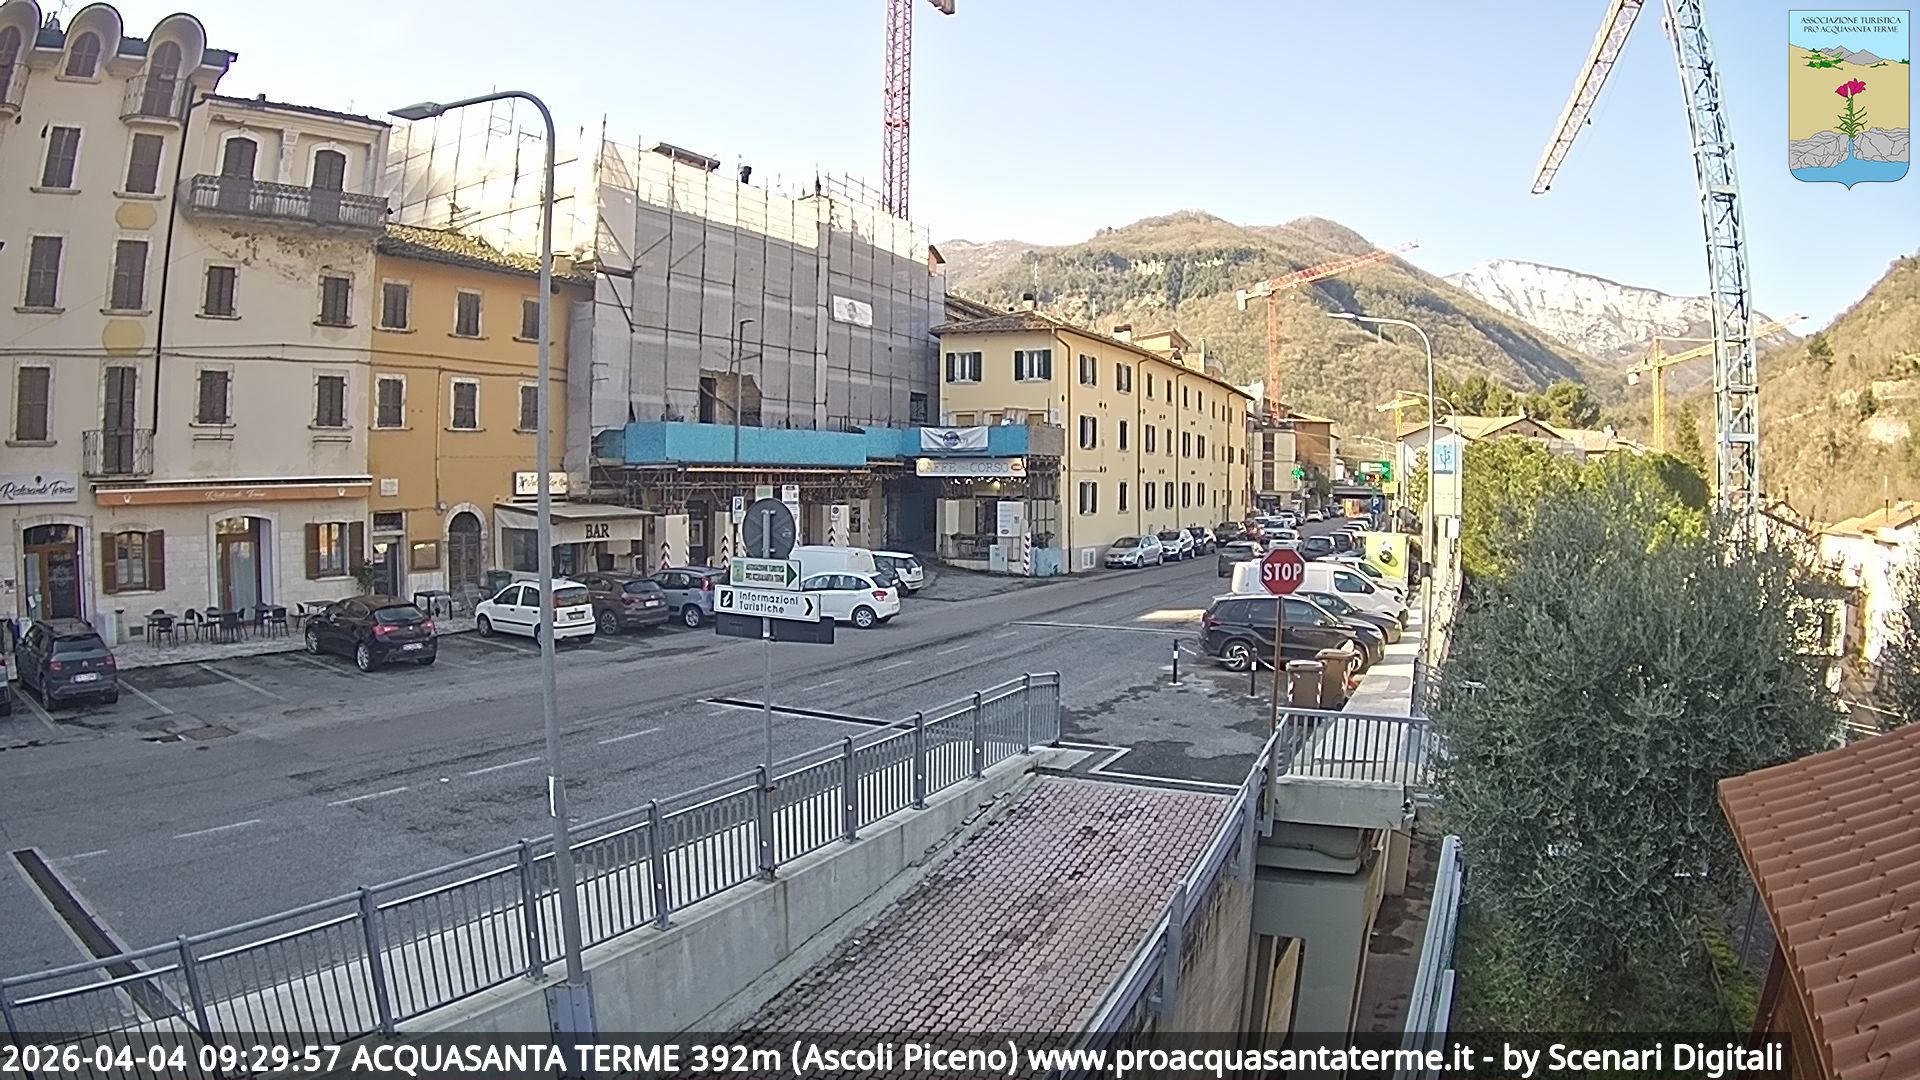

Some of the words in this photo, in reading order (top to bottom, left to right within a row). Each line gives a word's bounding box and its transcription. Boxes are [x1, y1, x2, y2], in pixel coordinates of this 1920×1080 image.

[969, 462, 1009, 473] CORSO
[585, 523, 610, 539] BAR
[1263, 562, 1302, 581] STOP
[739, 591, 799, 606] Informazioni
[739, 600, 785, 614] Turistiche
